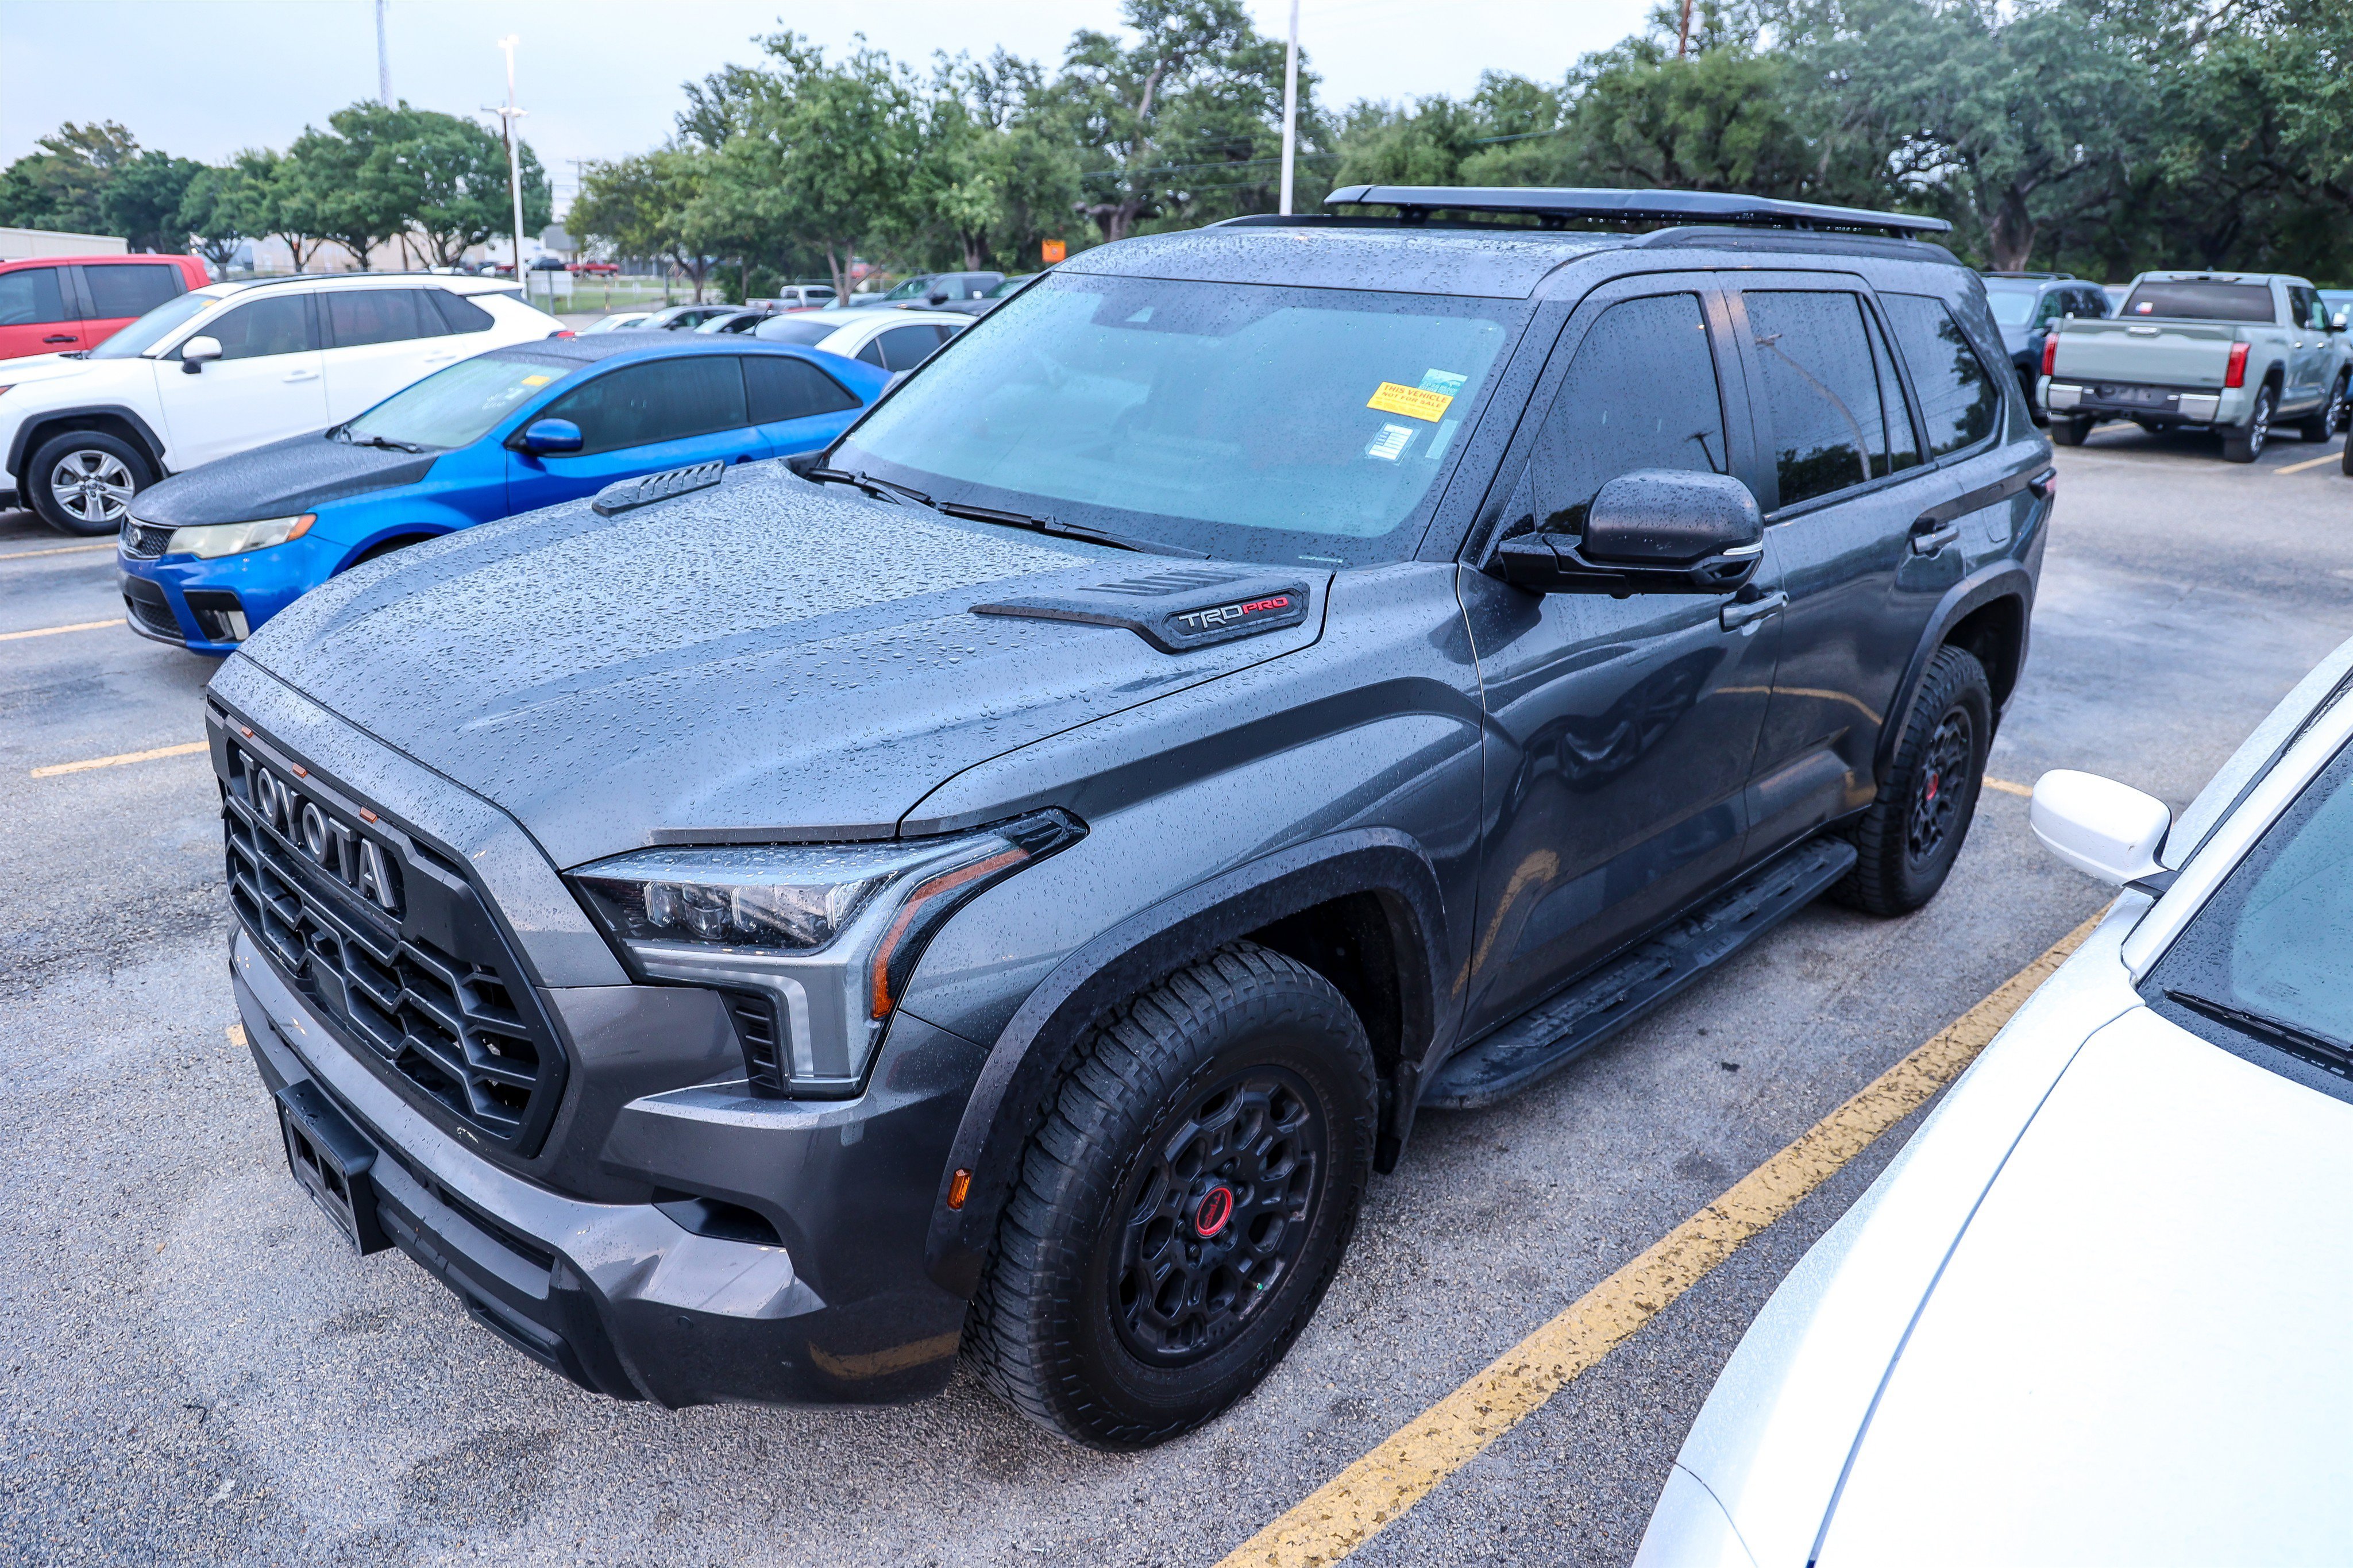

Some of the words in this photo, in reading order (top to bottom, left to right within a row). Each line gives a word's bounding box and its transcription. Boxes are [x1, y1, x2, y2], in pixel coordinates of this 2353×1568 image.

[1382, 392, 1398, 400] NOT
[1401, 395, 1418, 403] FOR
[1420, 399, 1442, 408] SALE
[1384, 384, 1405, 394] THIS
[1409, 389, 1448, 404] VEHICLE
[1178, 604, 1243, 629] TRD
[1243, 597, 1289, 615] PRO
[239, 749, 396, 909] TOYOTA
